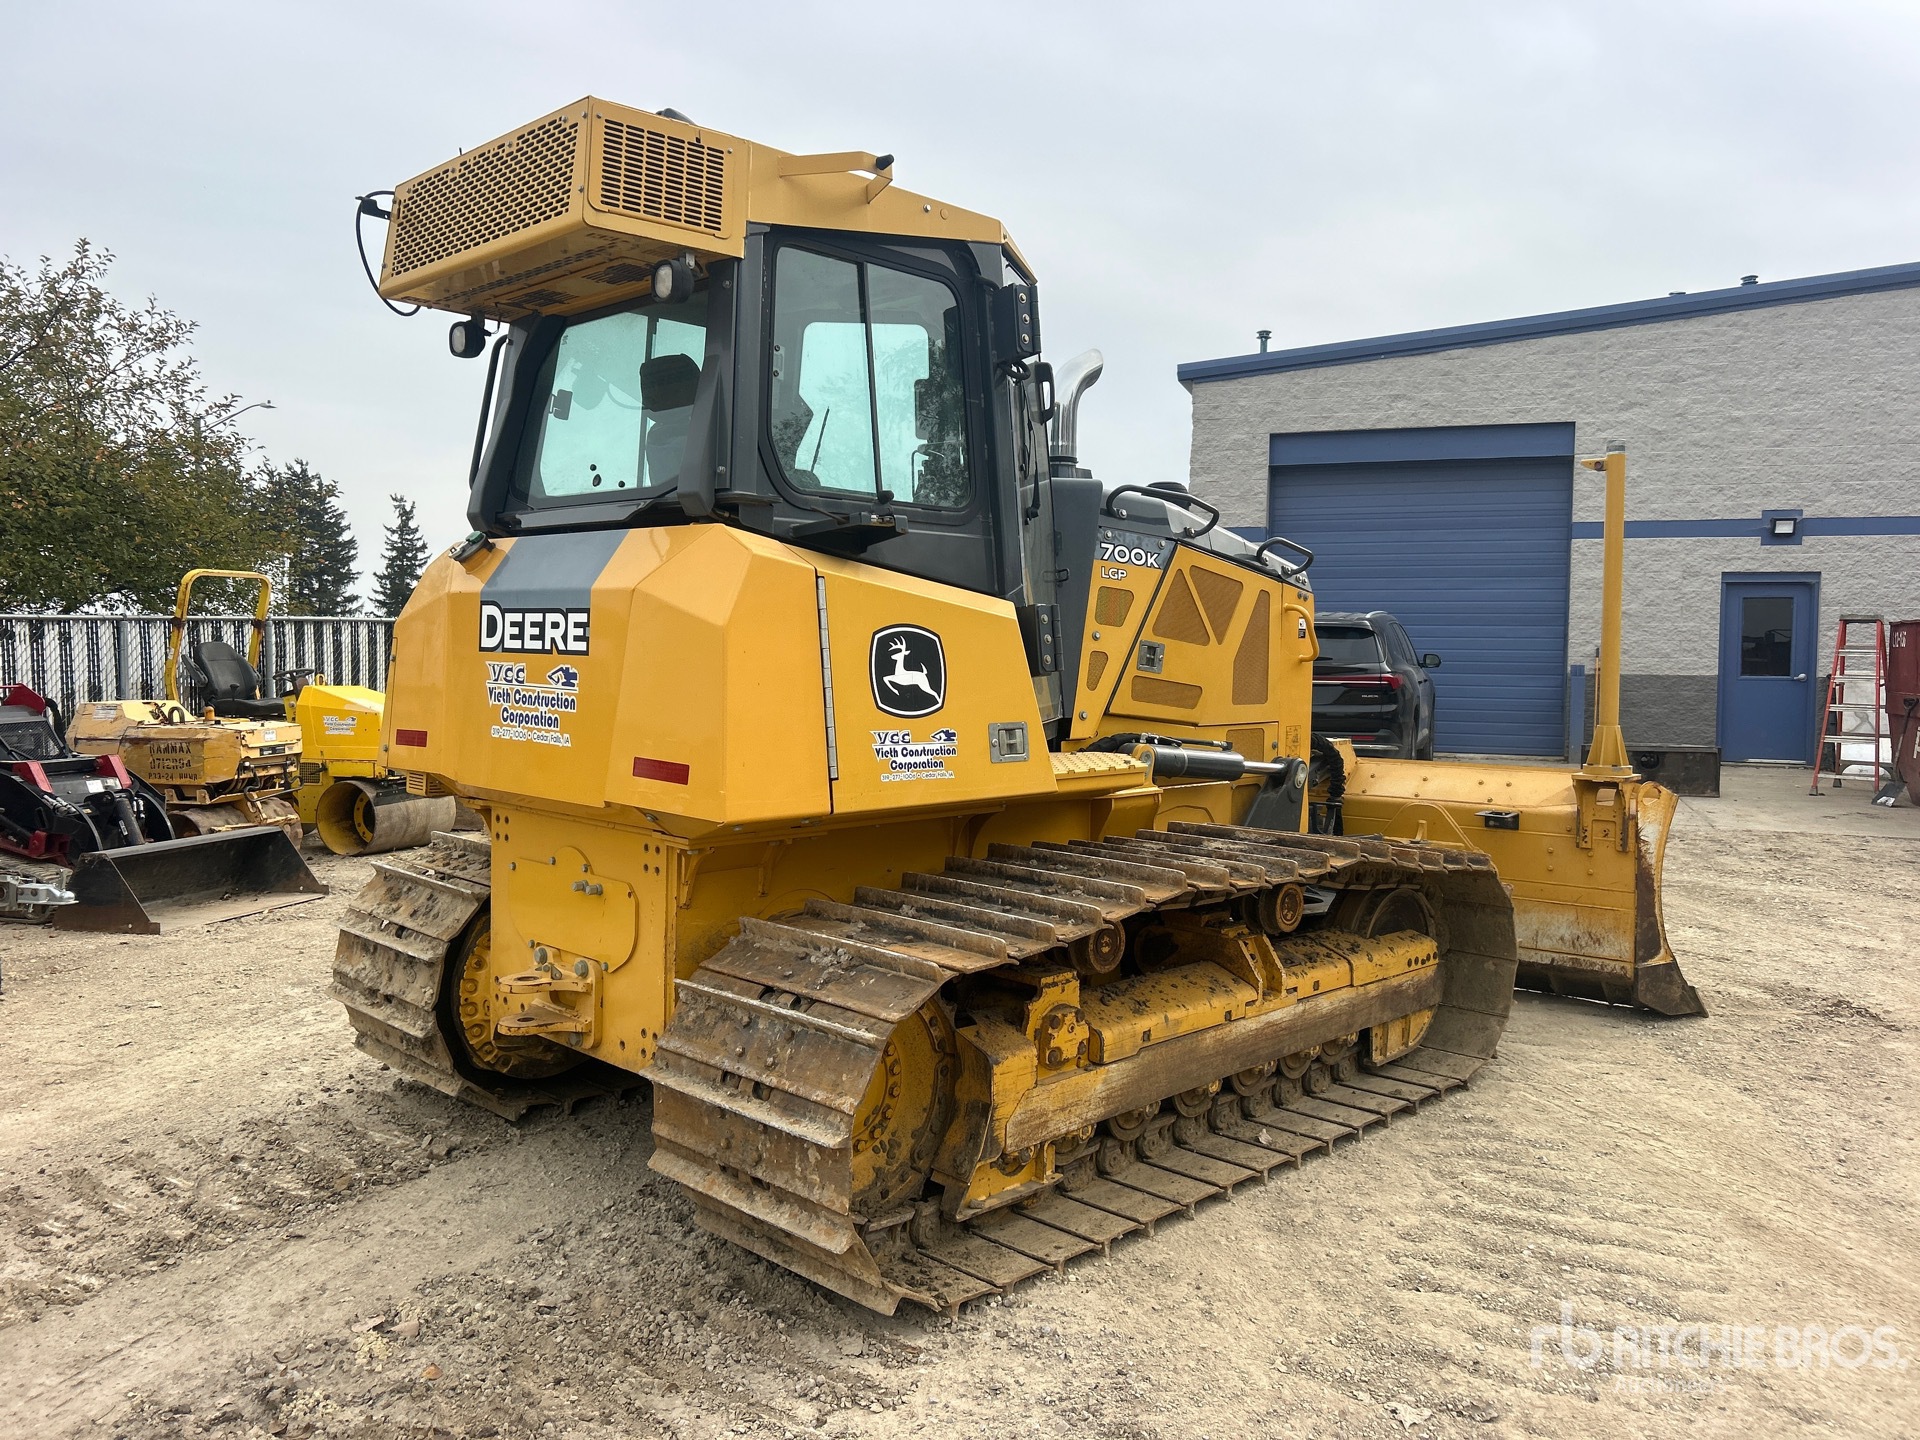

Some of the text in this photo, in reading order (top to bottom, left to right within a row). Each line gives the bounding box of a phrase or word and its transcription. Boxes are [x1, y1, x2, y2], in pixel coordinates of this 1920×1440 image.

[1100, 542, 1160, 569] 700K
[1101, 566, 1127, 580] LGP
[480, 602, 589, 652] DEERE
[487, 663, 525, 684] VCC
[488, 686, 576, 711] Vieth Construction
[502, 706, 559, 729] Corporation
[873, 731, 911, 744] VCC
[875, 745, 957, 759] Vieth Construction
[890, 758, 944, 772] Corporation
